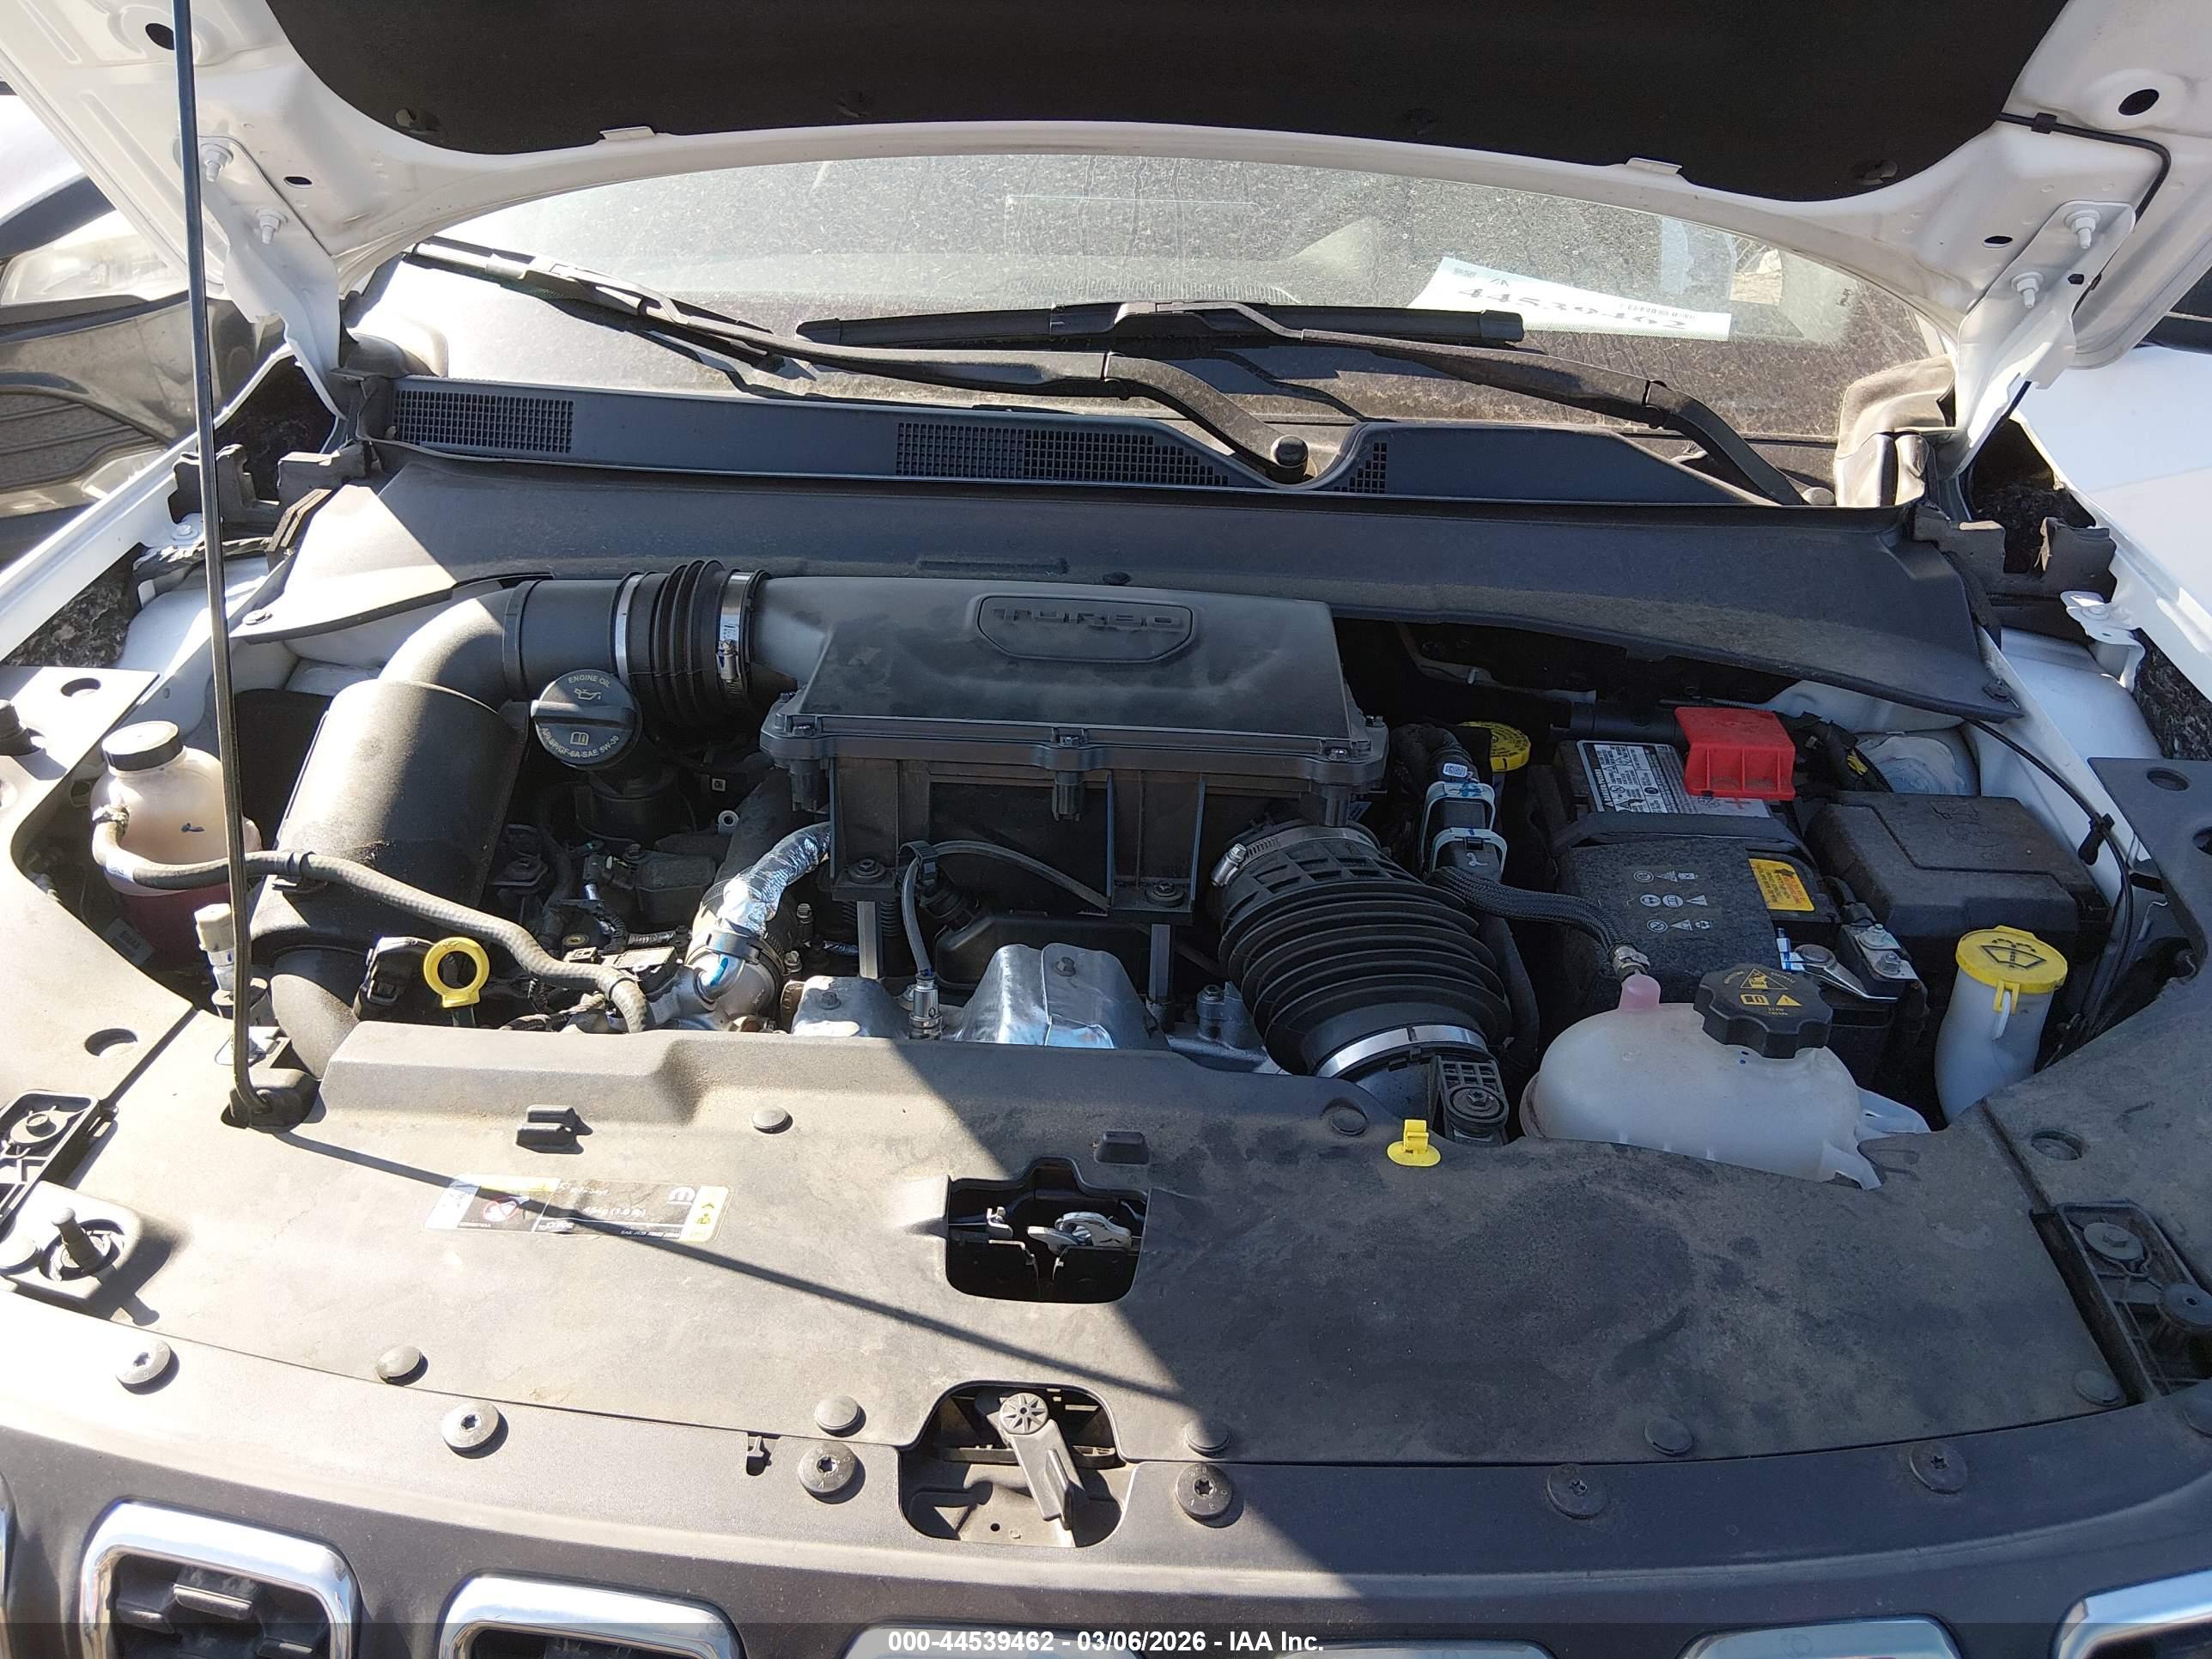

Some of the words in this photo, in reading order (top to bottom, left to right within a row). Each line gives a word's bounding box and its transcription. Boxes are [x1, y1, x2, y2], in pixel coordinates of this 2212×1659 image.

[992, 606, 1185, 631] TURBO
[568, 674, 598, 684] ENGINE
[599, 677, 611, 688] OIL
[599, 735, 619, 754] 5W-30
